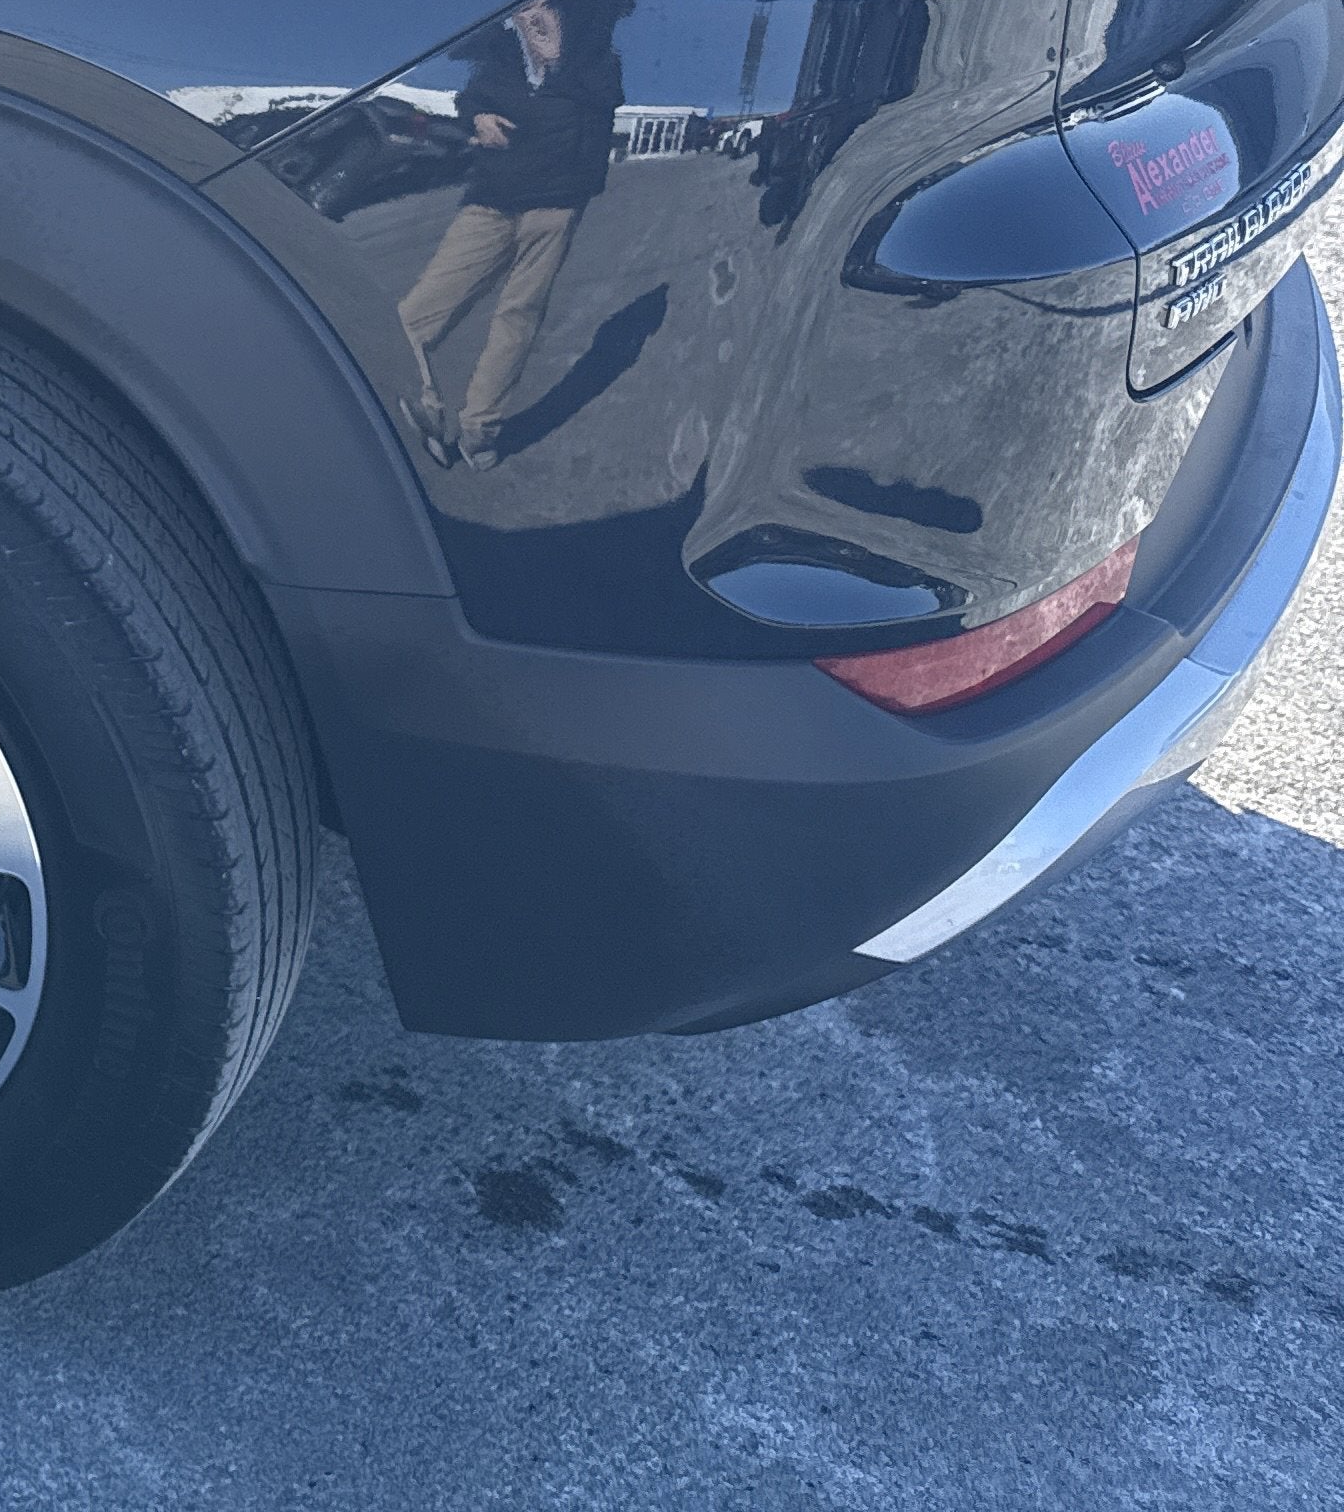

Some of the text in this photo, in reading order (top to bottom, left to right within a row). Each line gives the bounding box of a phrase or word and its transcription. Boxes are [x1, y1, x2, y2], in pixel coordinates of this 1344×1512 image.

[1126, 126, 1218, 216] Alexander
[1171, 160, 1312, 287] TRAILBLAZER
[1167, 273, 1227, 330] AWD
